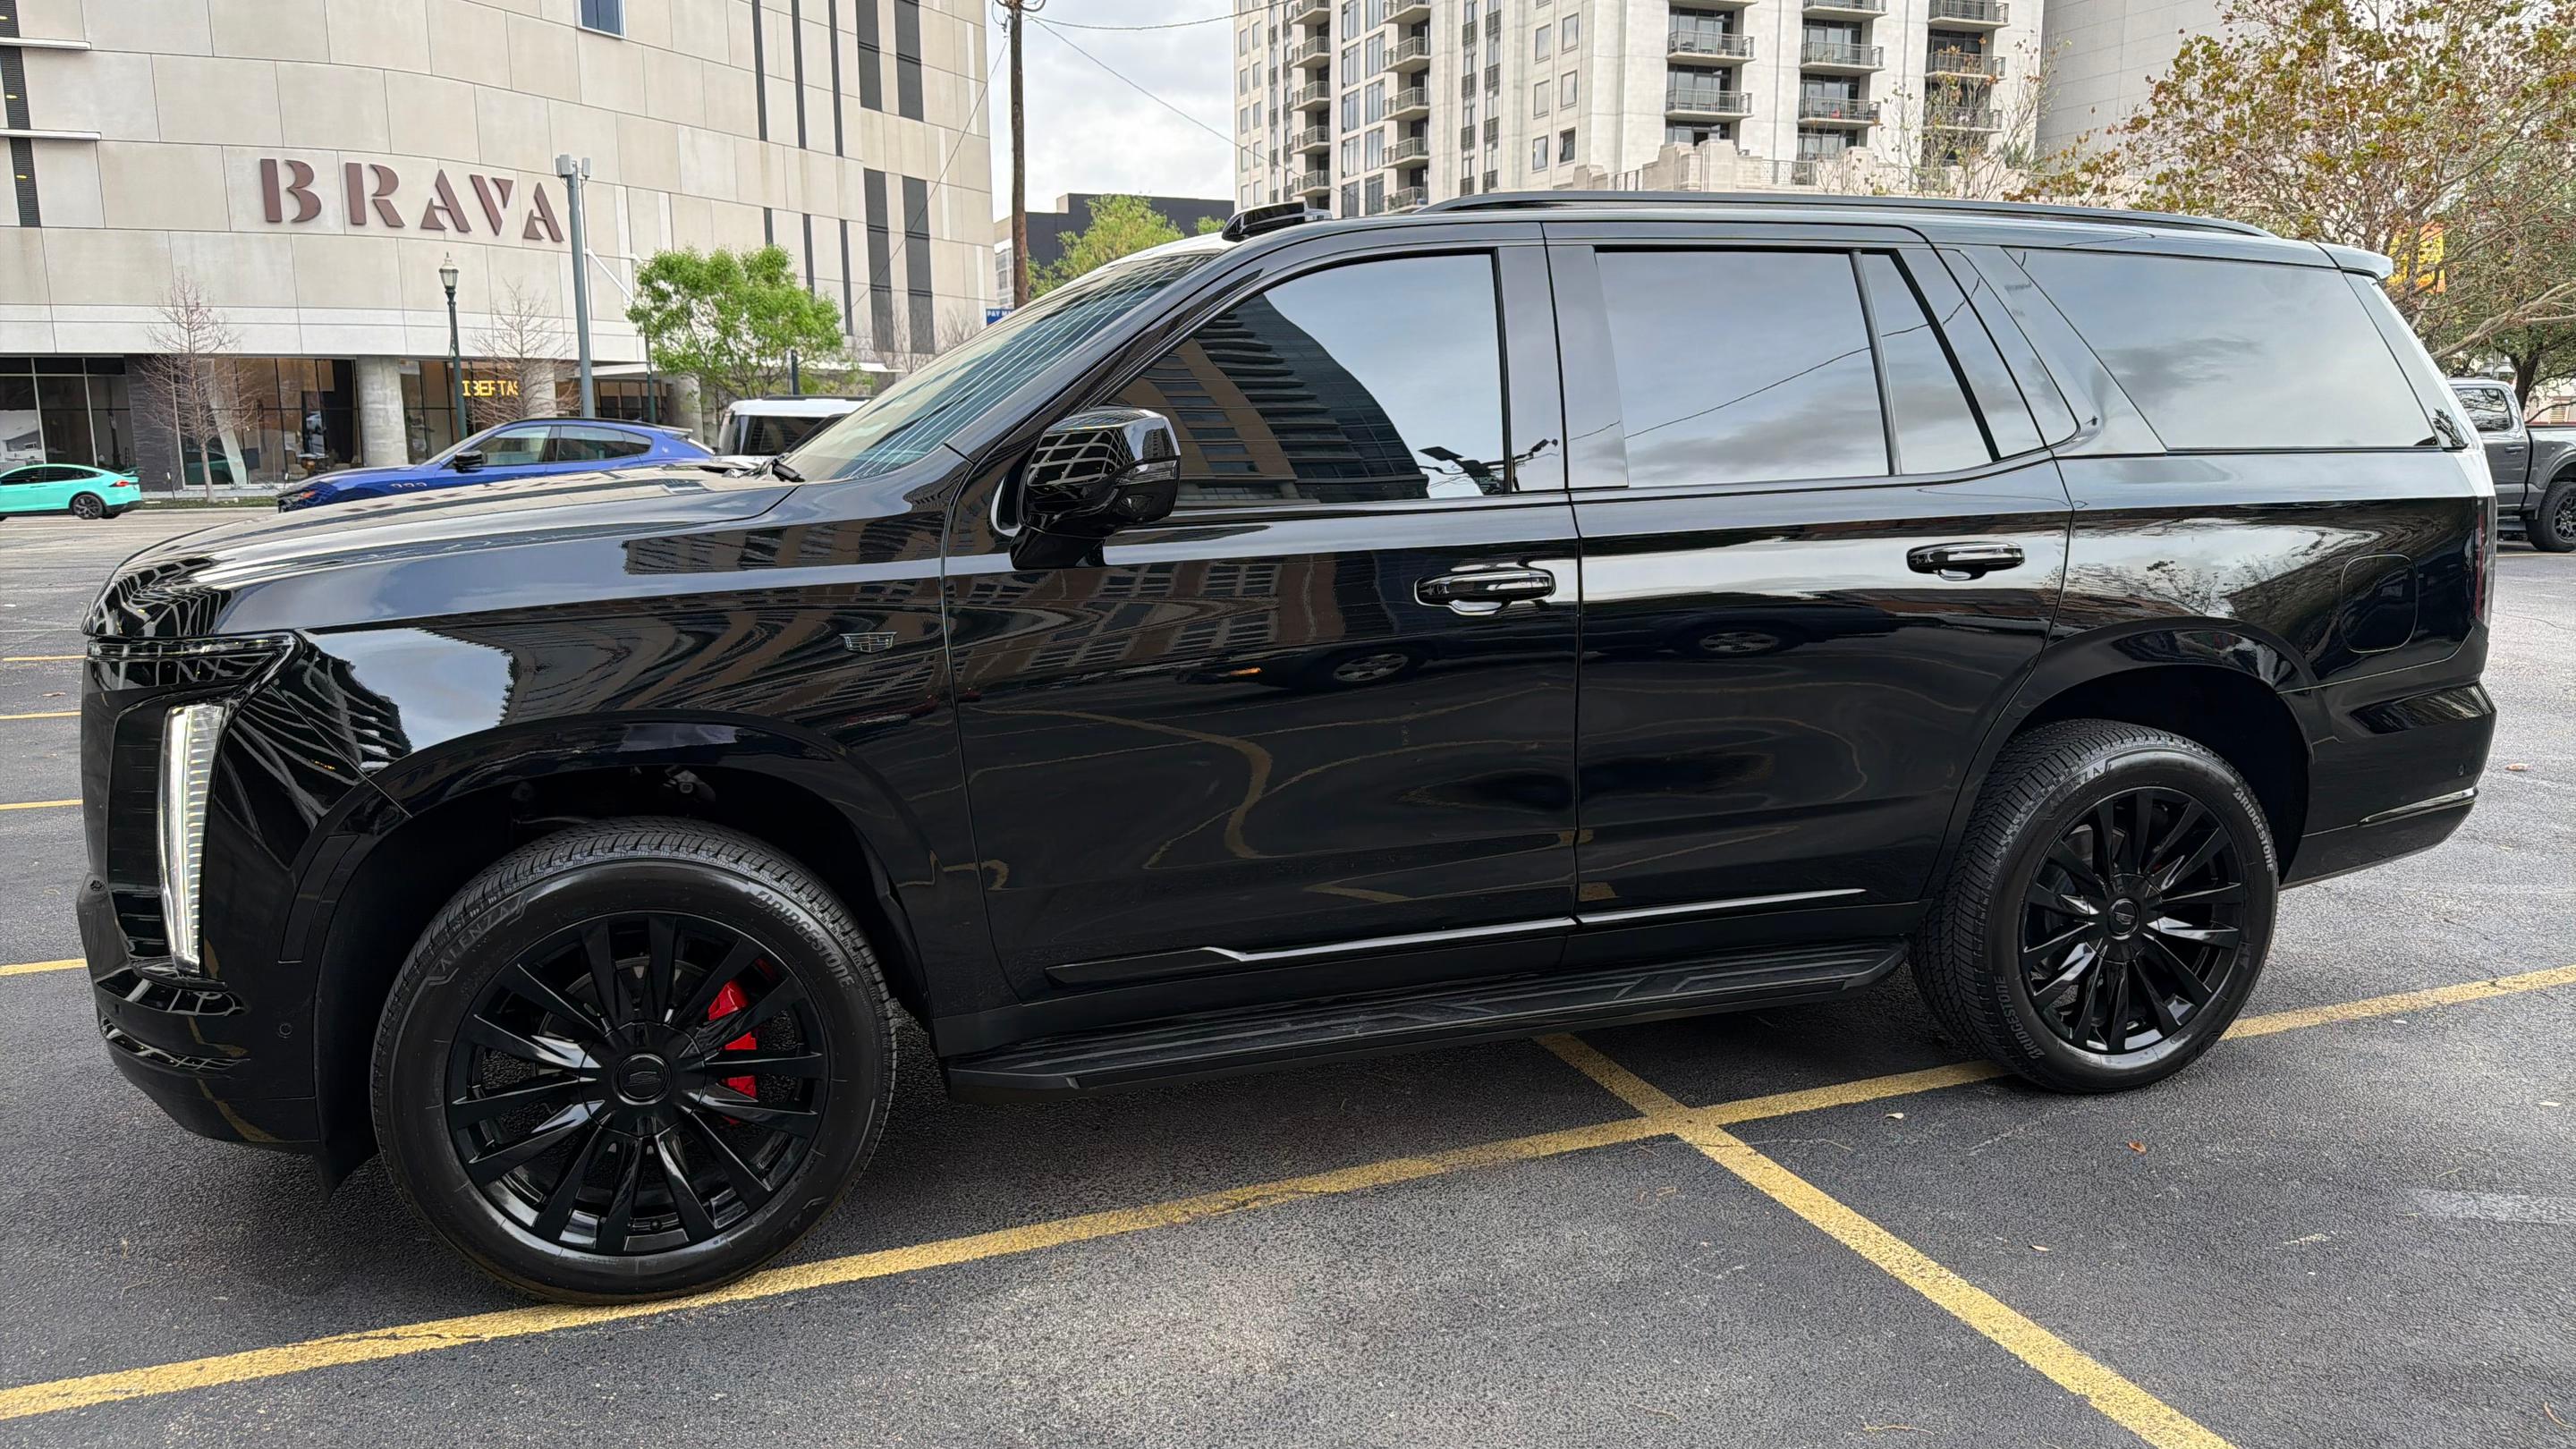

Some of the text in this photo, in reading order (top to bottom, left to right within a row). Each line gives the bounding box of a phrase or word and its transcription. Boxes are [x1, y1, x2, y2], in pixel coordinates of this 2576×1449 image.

[259, 157, 565, 243] BRAVA
[987, 309, 1001, 318] PAY
[2233, 786, 2275, 872] BRIDGESTONE
[431, 903, 513, 972] ALENZA
[750, 891, 856, 987] BRIDGESTONE
[1993, 975, 2046, 1059] BRIDGESTONE
